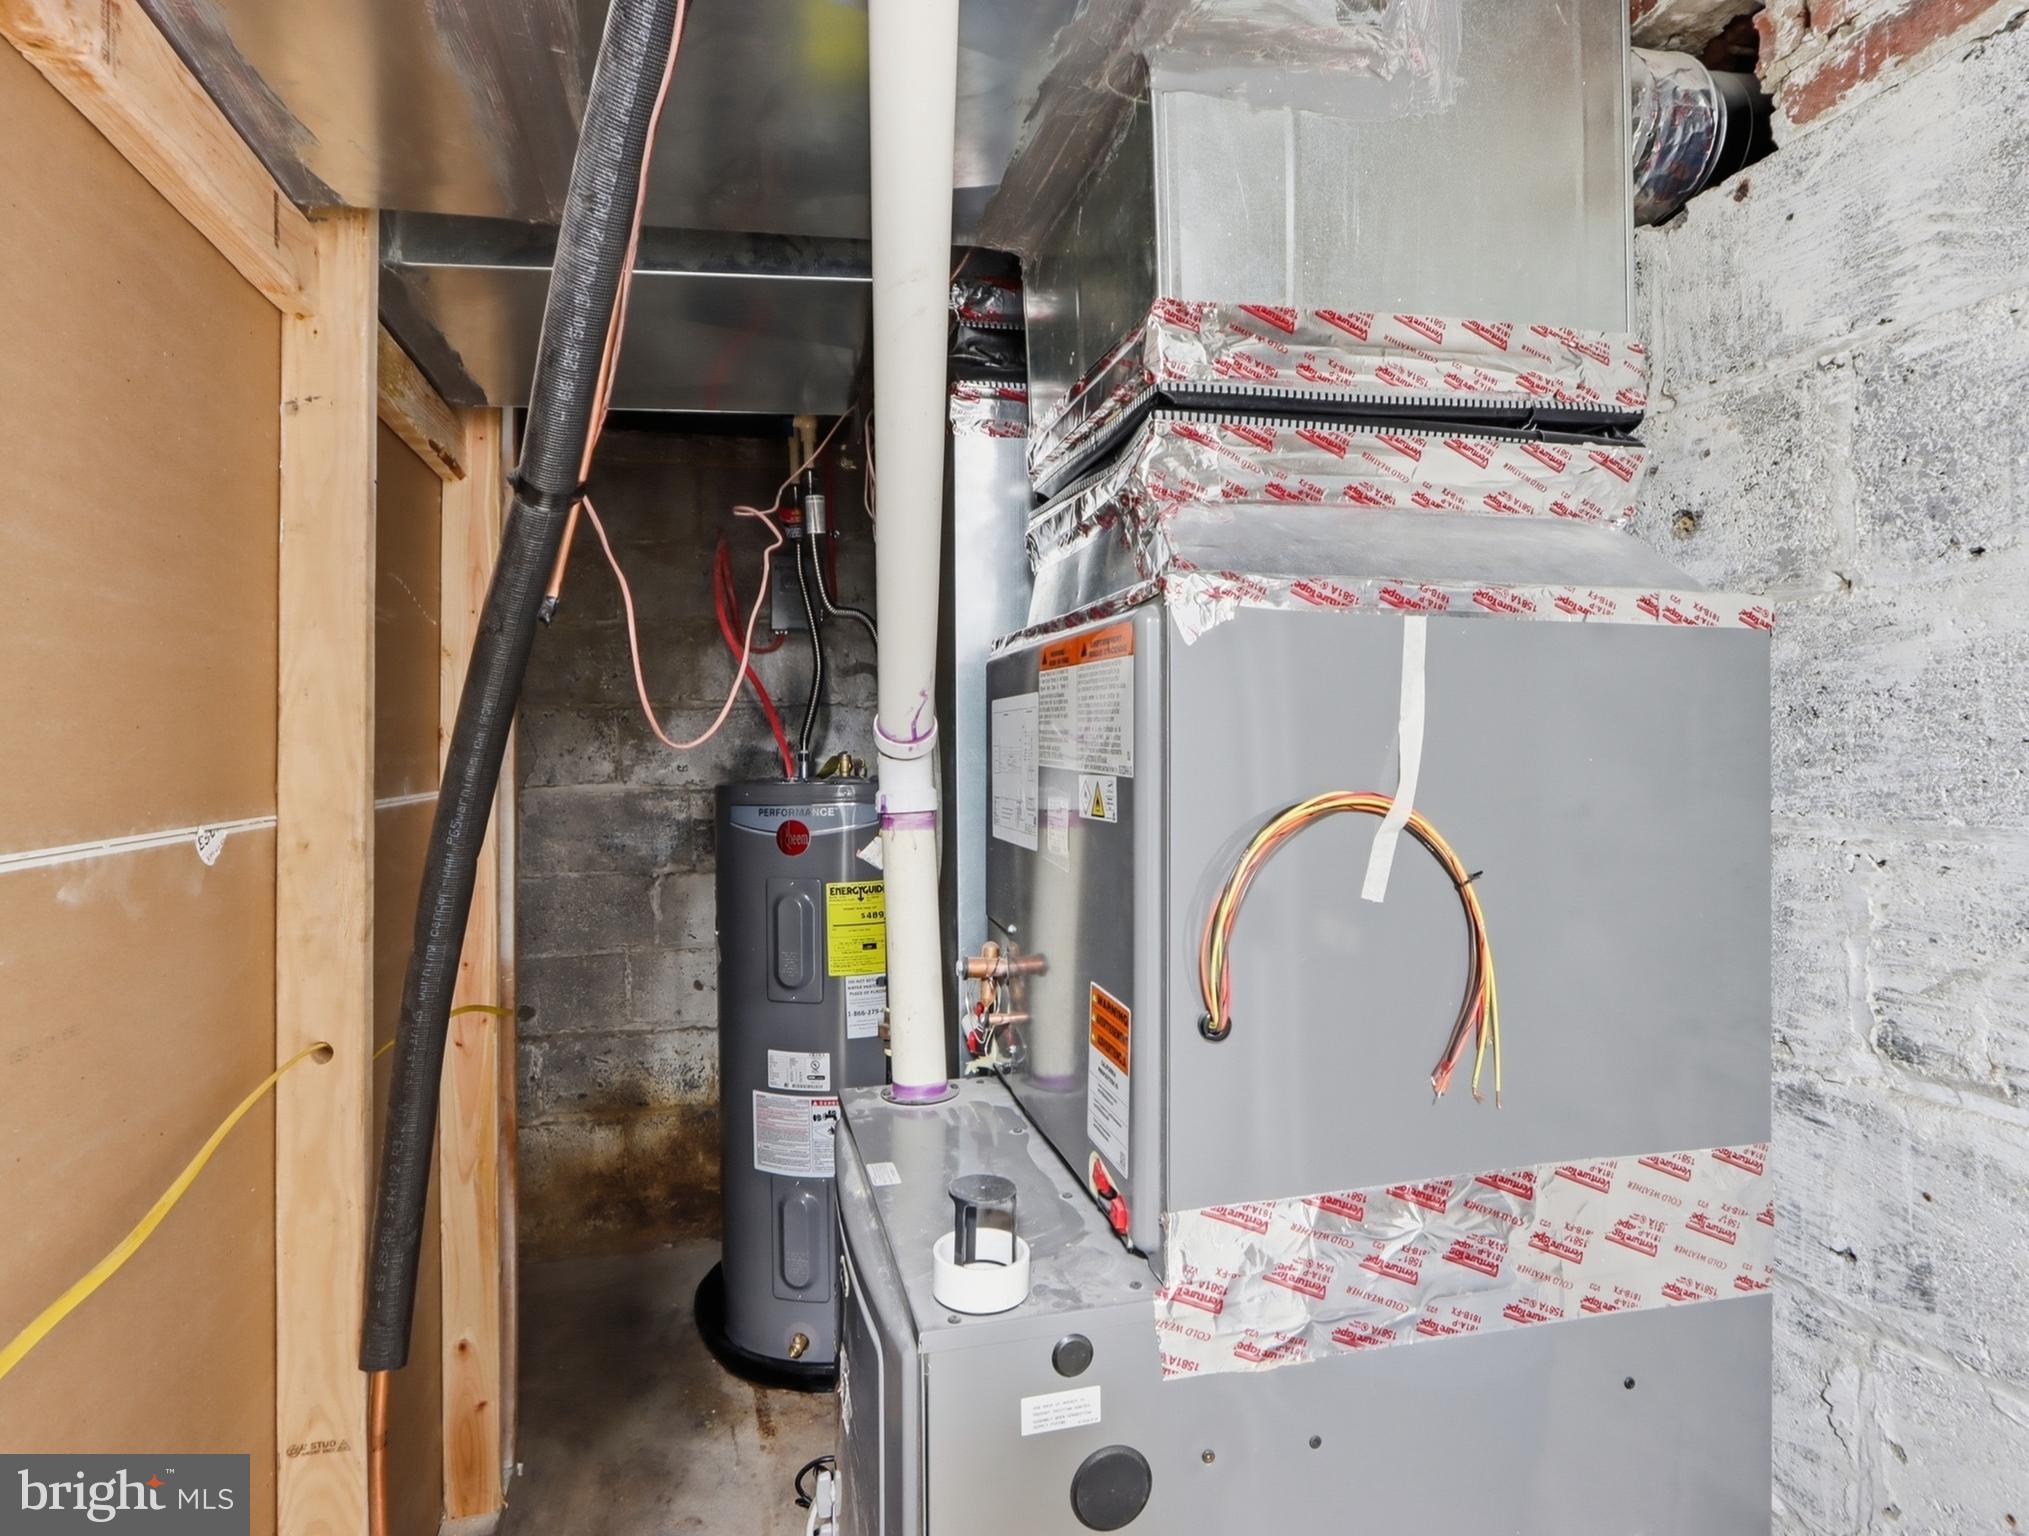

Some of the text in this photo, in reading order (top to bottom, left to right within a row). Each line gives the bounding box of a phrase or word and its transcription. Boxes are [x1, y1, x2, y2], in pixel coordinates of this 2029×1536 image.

[1383, 334, 1416, 352] WEATHER
[1360, 451, 1410, 483] COLD WEATHER
[1502, 462, 1548, 492] COLD WEATHER
[1329, 586, 1361, 603] 1581A
[1509, 594, 1537, 610] 1581A
[758, 808, 836, 817] PERFORMANCE
[830, 884, 885, 898] ENERGYGUID
[1626, 1181, 1682, 1206] COLD WEATHER
[1462, 1199, 1500, 1218] WEATHER
[1290, 1223, 1353, 1248] COLD WEATHER
[1673, 1244, 1727, 1269] COLD WEATHER
[1516, 1265, 1573, 1290] COLD WEATHER
[1345, 1286, 1408, 1312] COLD WEATHER
[1537, 1302, 1565, 1317] 1581A
[1185, 1328, 1211, 1341] COLD
